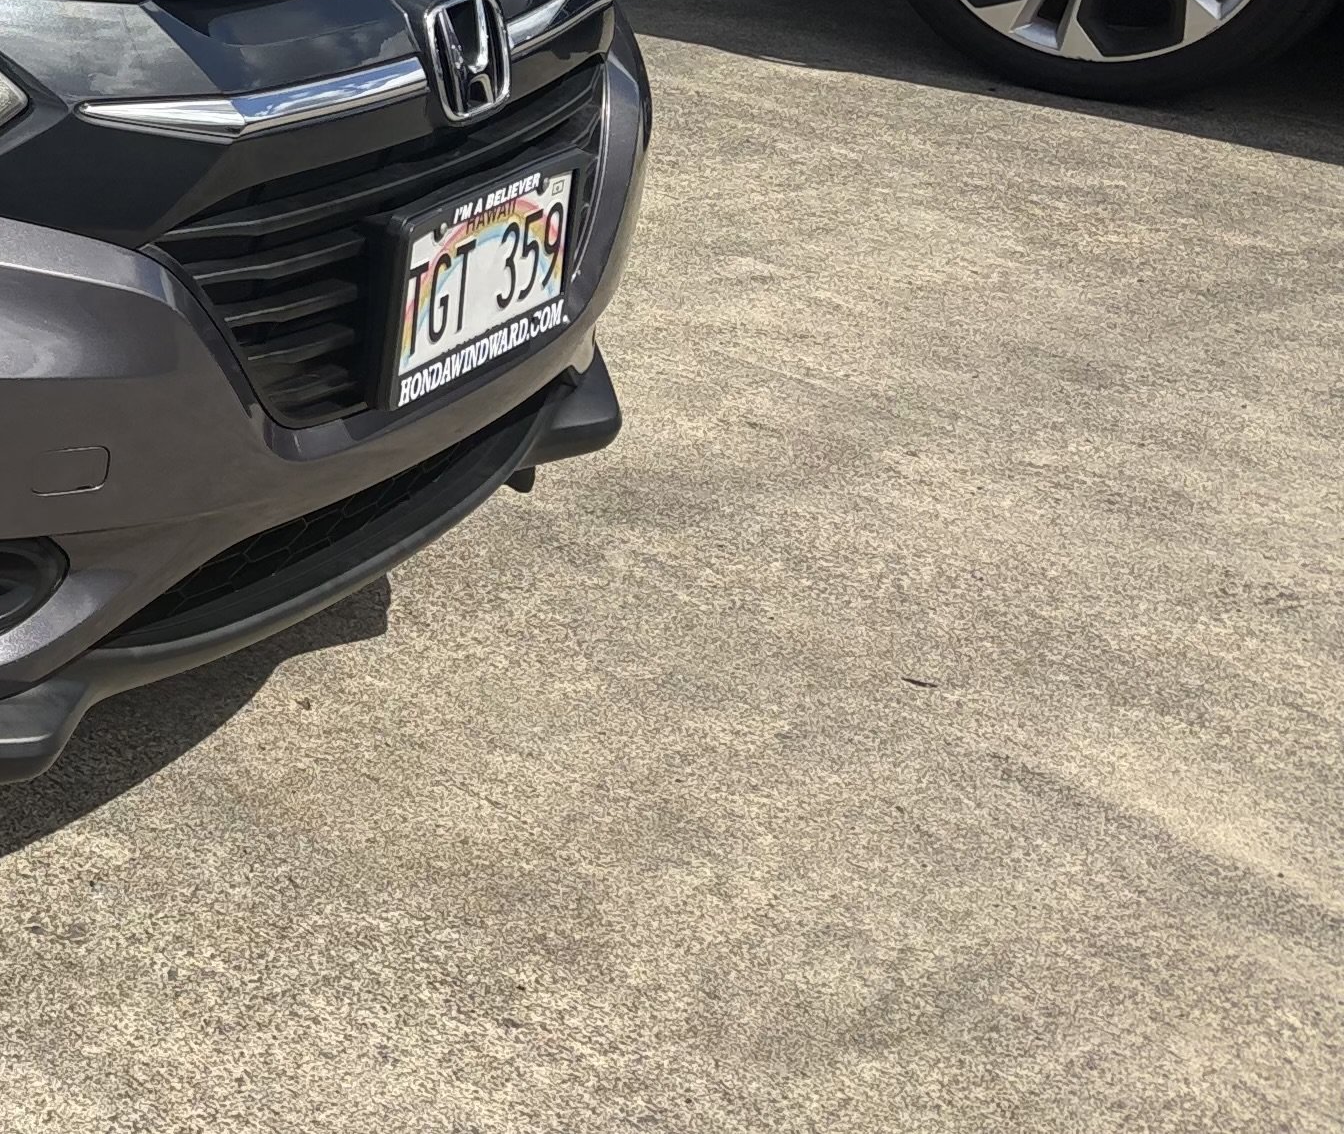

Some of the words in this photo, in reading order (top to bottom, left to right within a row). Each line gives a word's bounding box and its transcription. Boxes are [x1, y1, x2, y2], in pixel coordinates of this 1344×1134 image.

[453, 202, 474, 224] I'M
[474, 198, 484, 215] A
[485, 172, 541, 211] BELIEVER
[465, 199, 518, 235] HAWAII
[409, 239, 478, 356] TGT
[496, 202, 564, 310] 359
[398, 299, 565, 407] HONDAWINDWARD.COM
